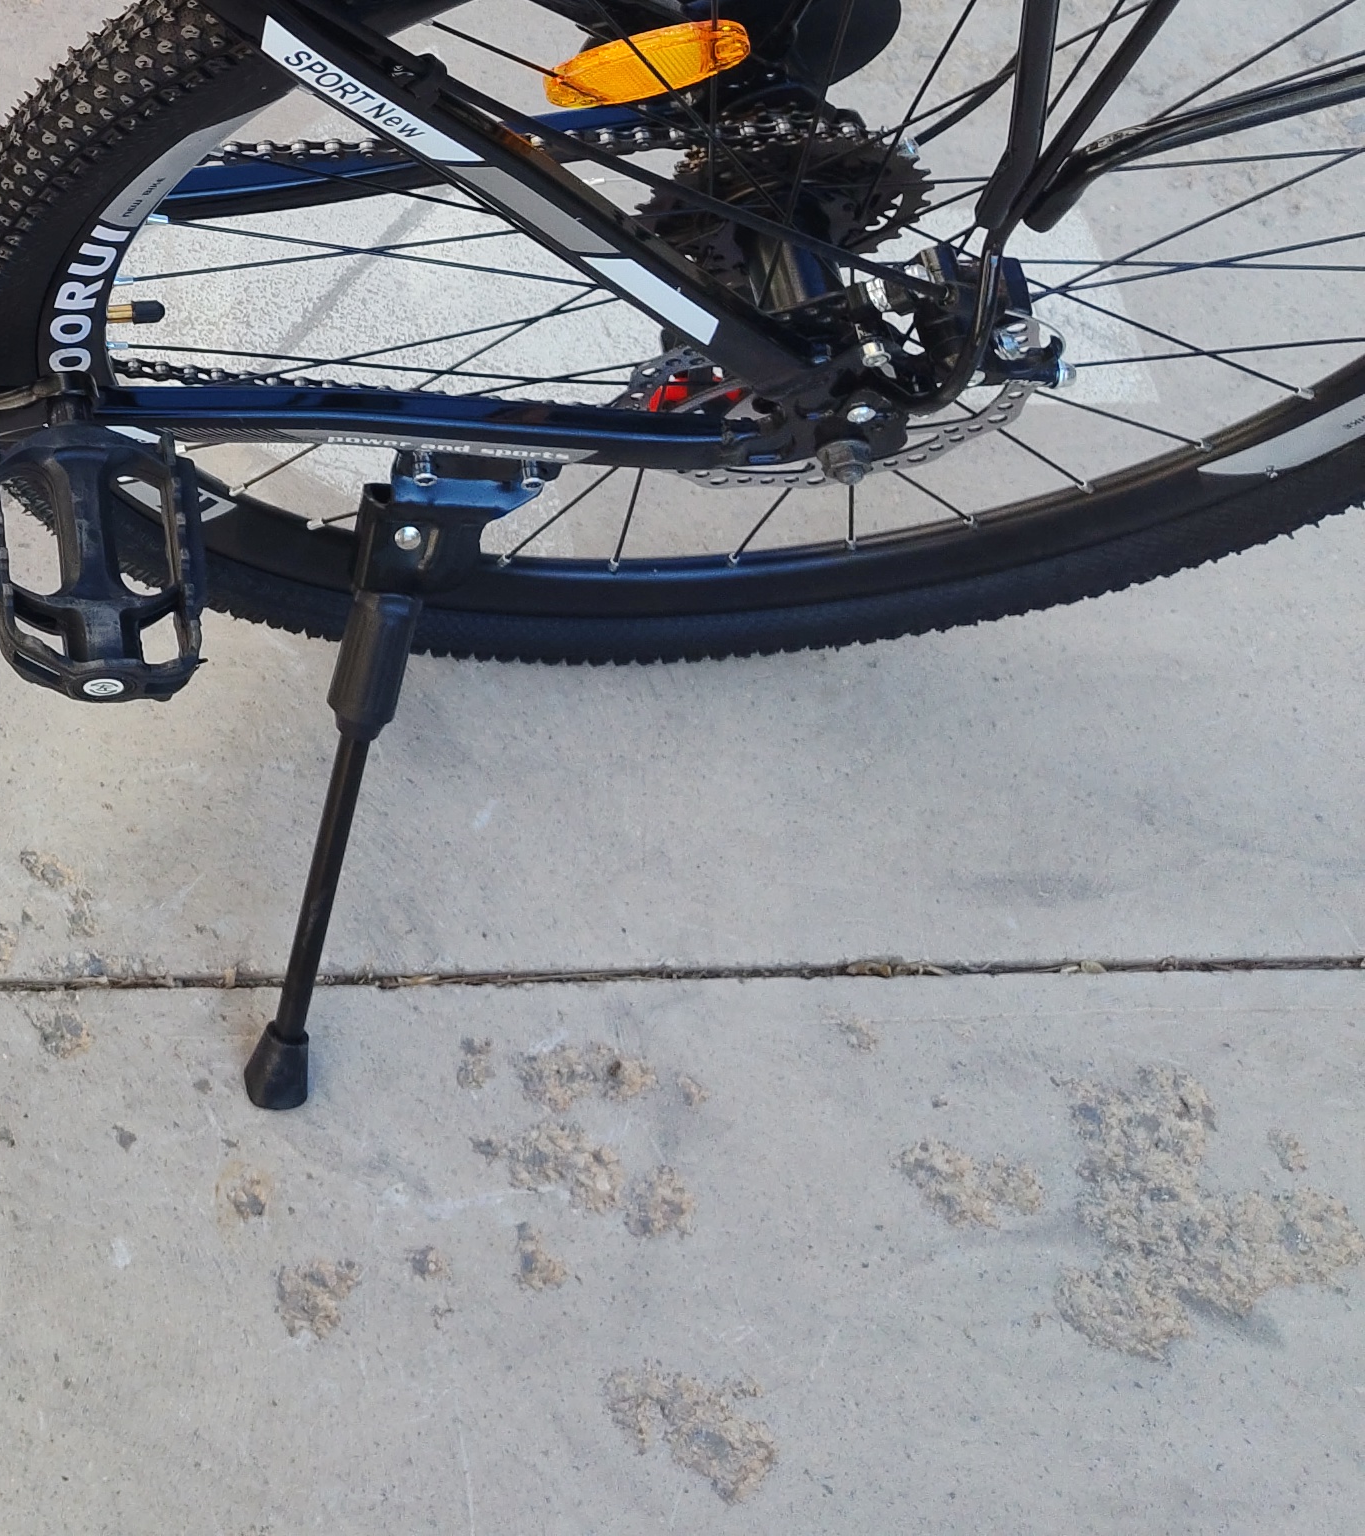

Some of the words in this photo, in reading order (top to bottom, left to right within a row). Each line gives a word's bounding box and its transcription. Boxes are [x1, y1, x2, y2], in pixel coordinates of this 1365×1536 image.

[284, 50, 376, 106] SPORT
[363, 102, 425, 138] New
[327, 435, 413, 448] power
[420, 442, 471, 454] and
[480, 446, 570, 461] sports
